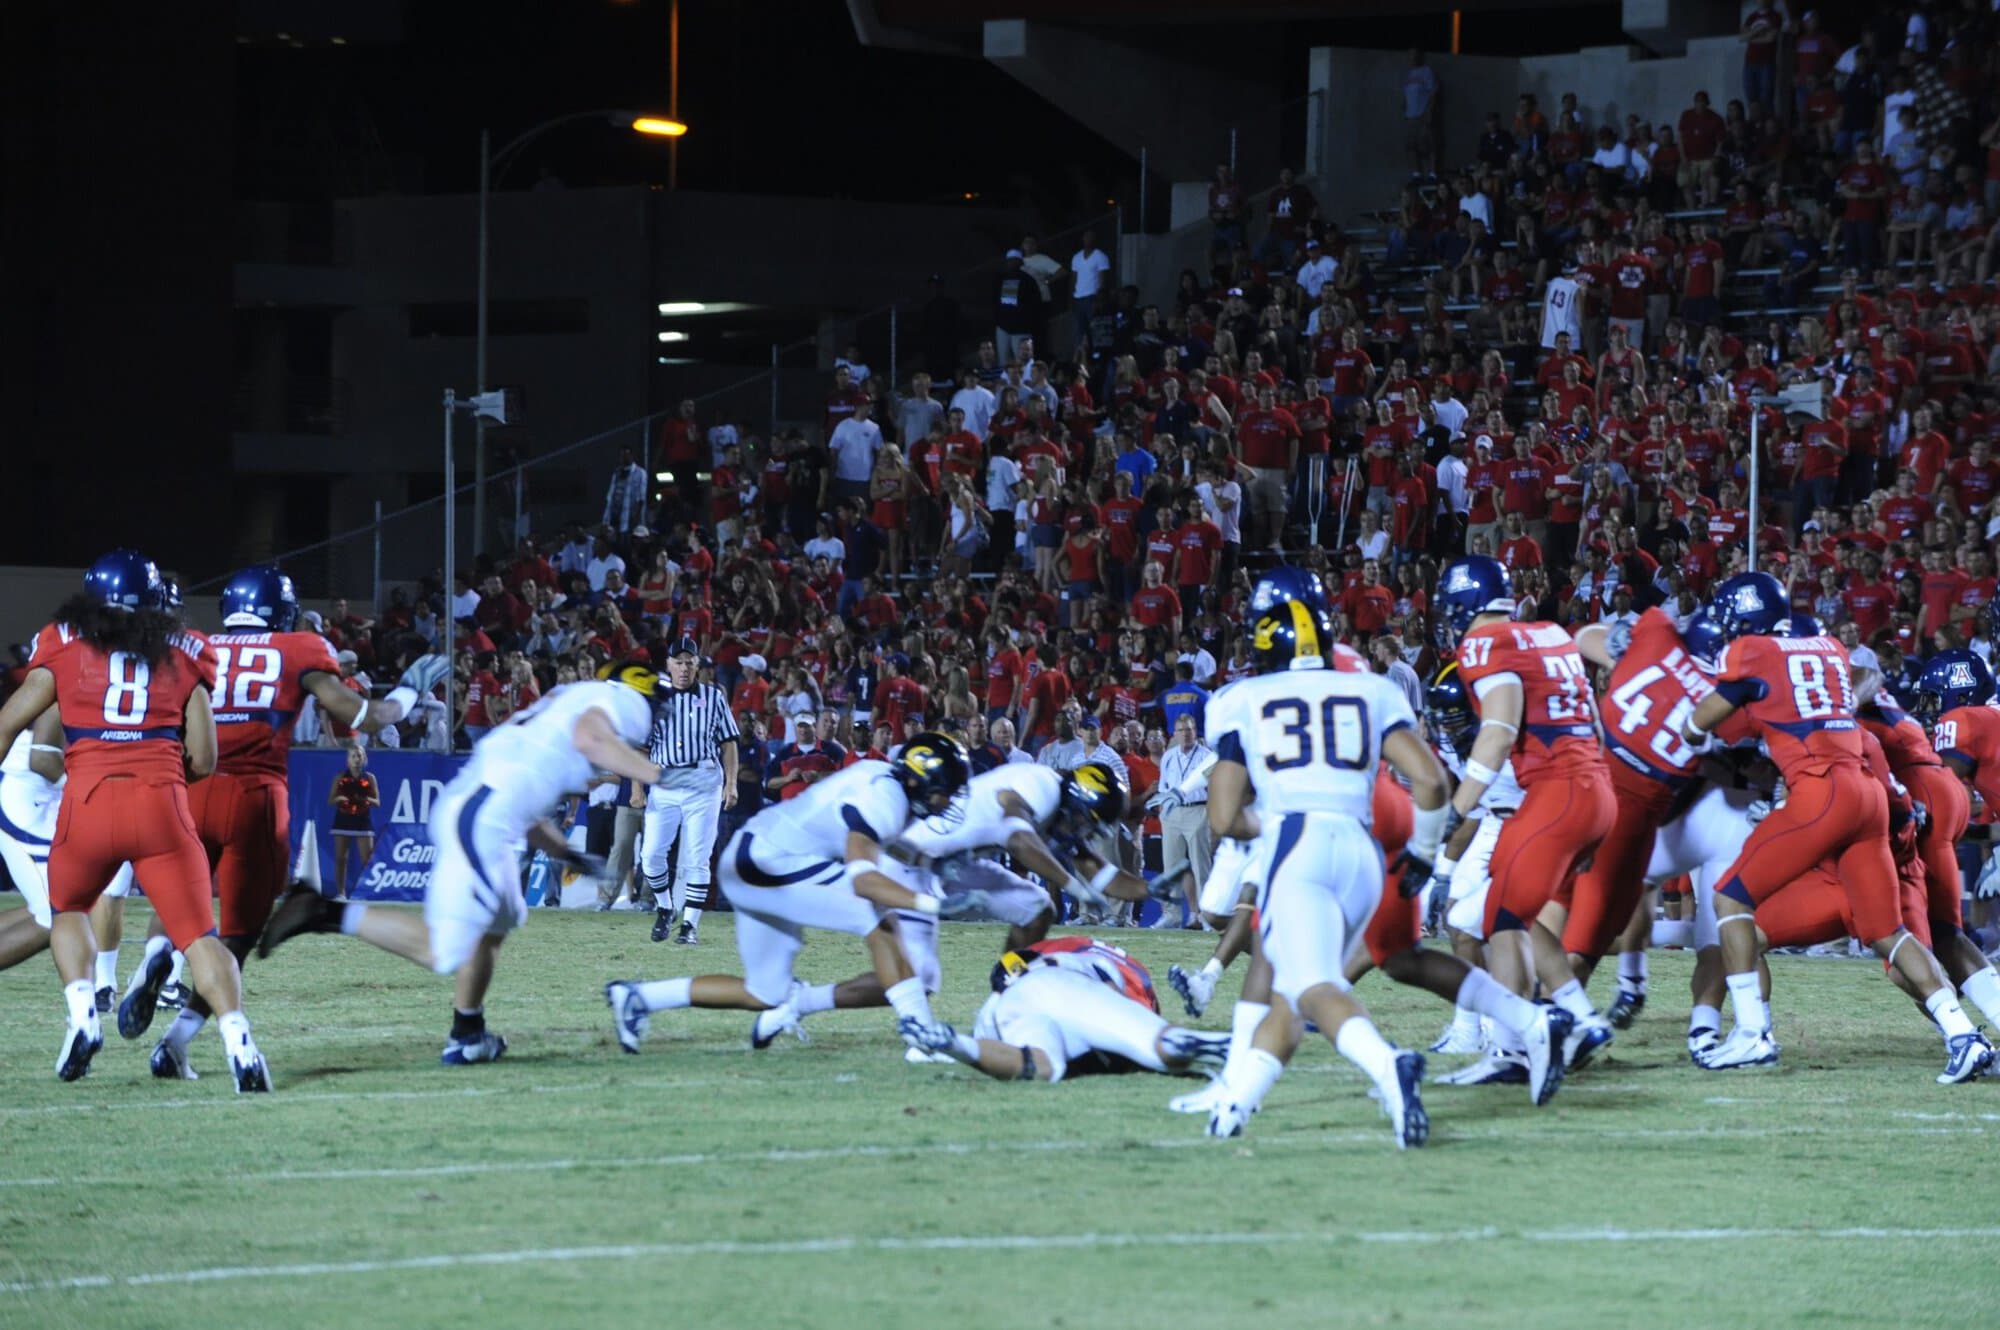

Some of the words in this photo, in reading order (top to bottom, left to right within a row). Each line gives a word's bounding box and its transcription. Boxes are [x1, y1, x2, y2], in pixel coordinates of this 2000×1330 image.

[1461, 636, 1495, 668] 37
[103, 651, 149, 725] 8
[858, 677, 869, 701] 7
[1787, 654, 1854, 718] 81
[1949, 661, 1977, 689] A
[100, 730, 143, 741] ARIZONA
[1261, 696, 1371, 773] 30
[1934, 720, 1957, 752] 29
